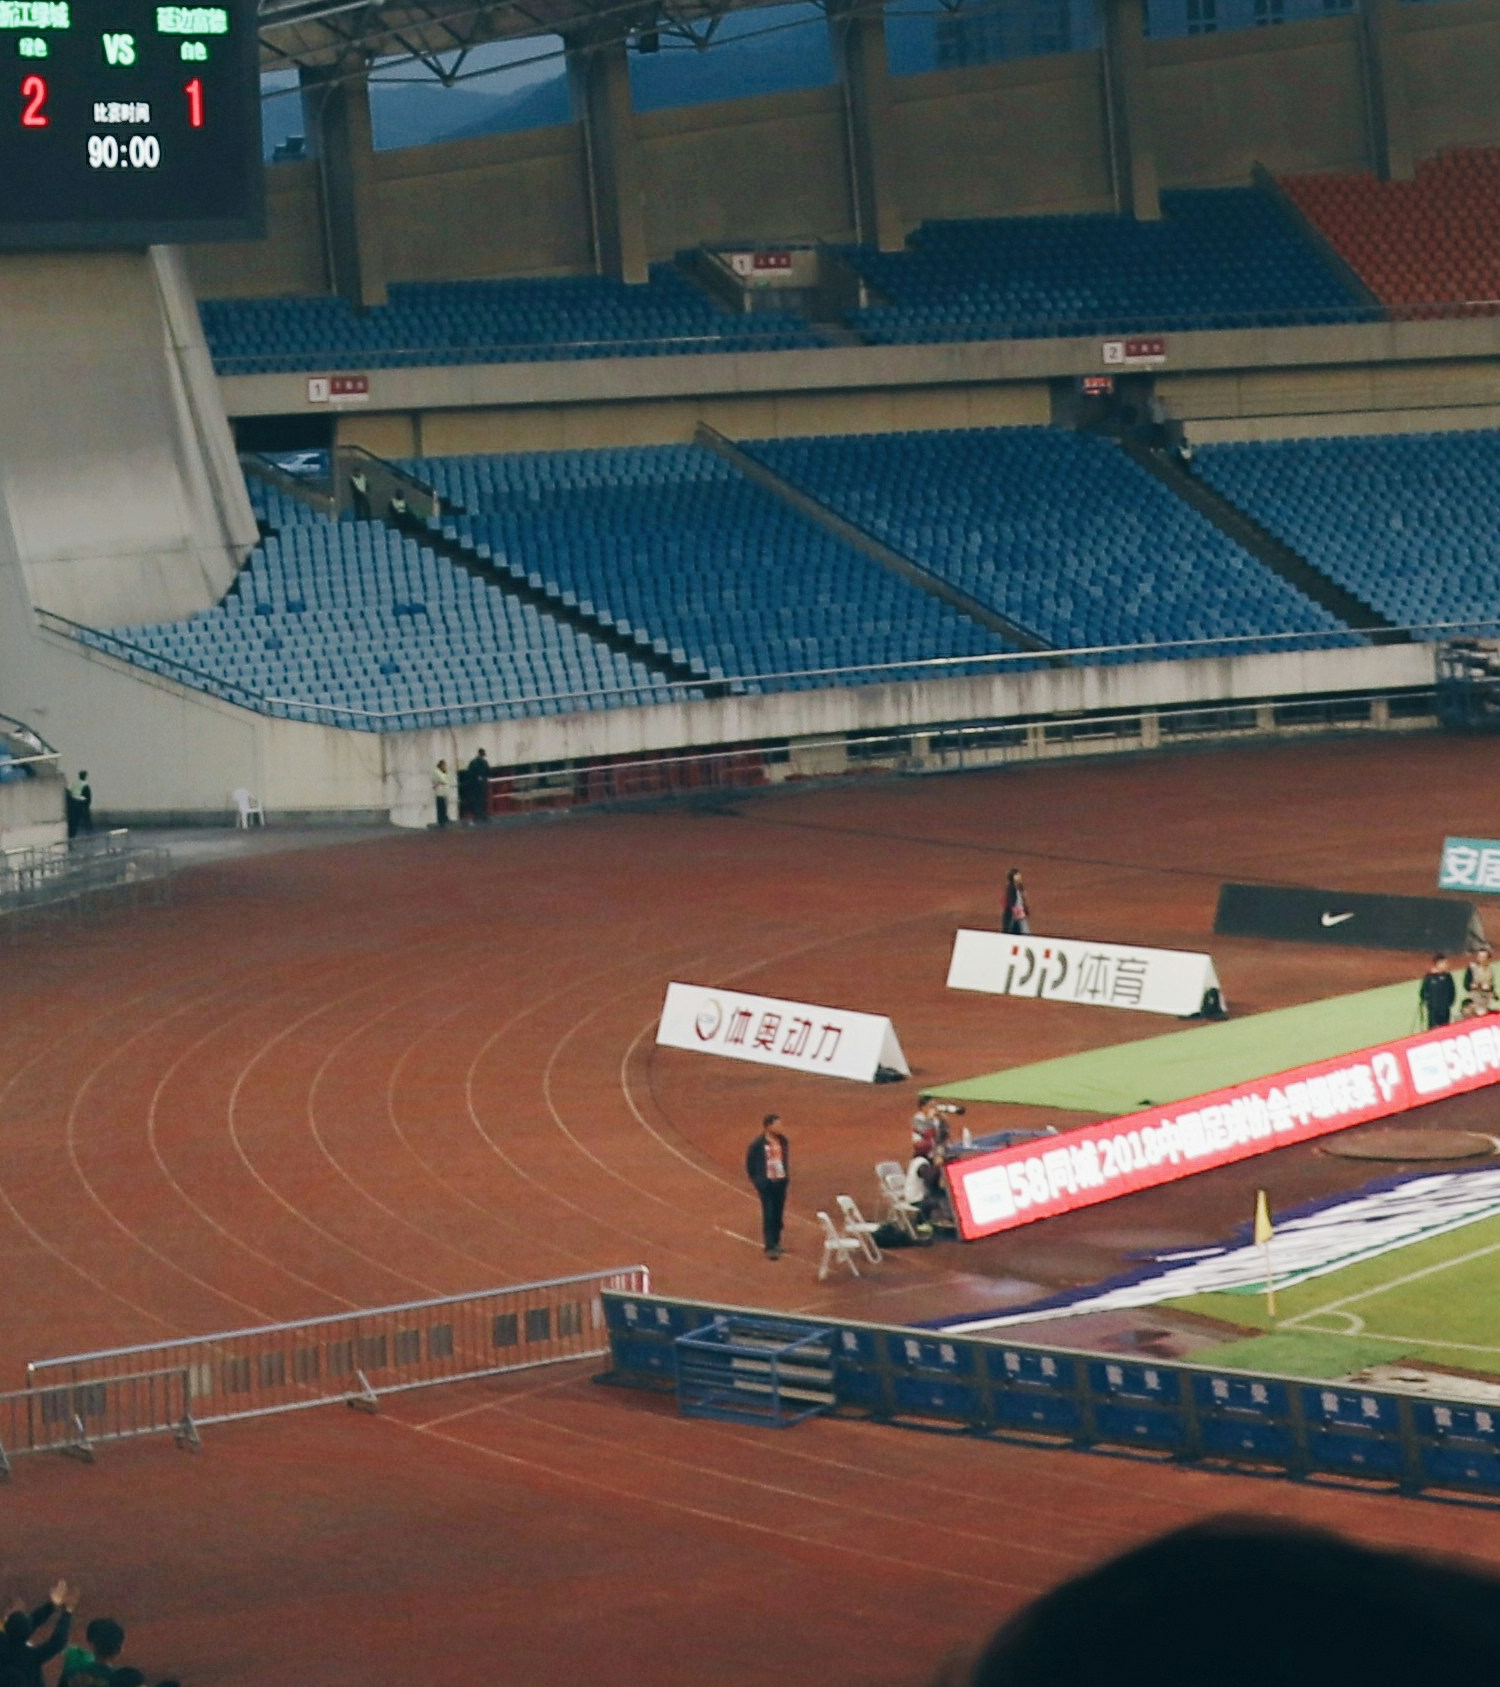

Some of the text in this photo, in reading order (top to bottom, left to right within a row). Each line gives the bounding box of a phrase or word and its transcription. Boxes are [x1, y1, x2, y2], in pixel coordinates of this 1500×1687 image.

[102, 34, 135, 65] VS
[20, 75, 48, 127] 2
[185, 78, 204, 127] 1
[87, 136, 160, 168] 90:00
[725, 1006, 843, 1062] 体奥动力
